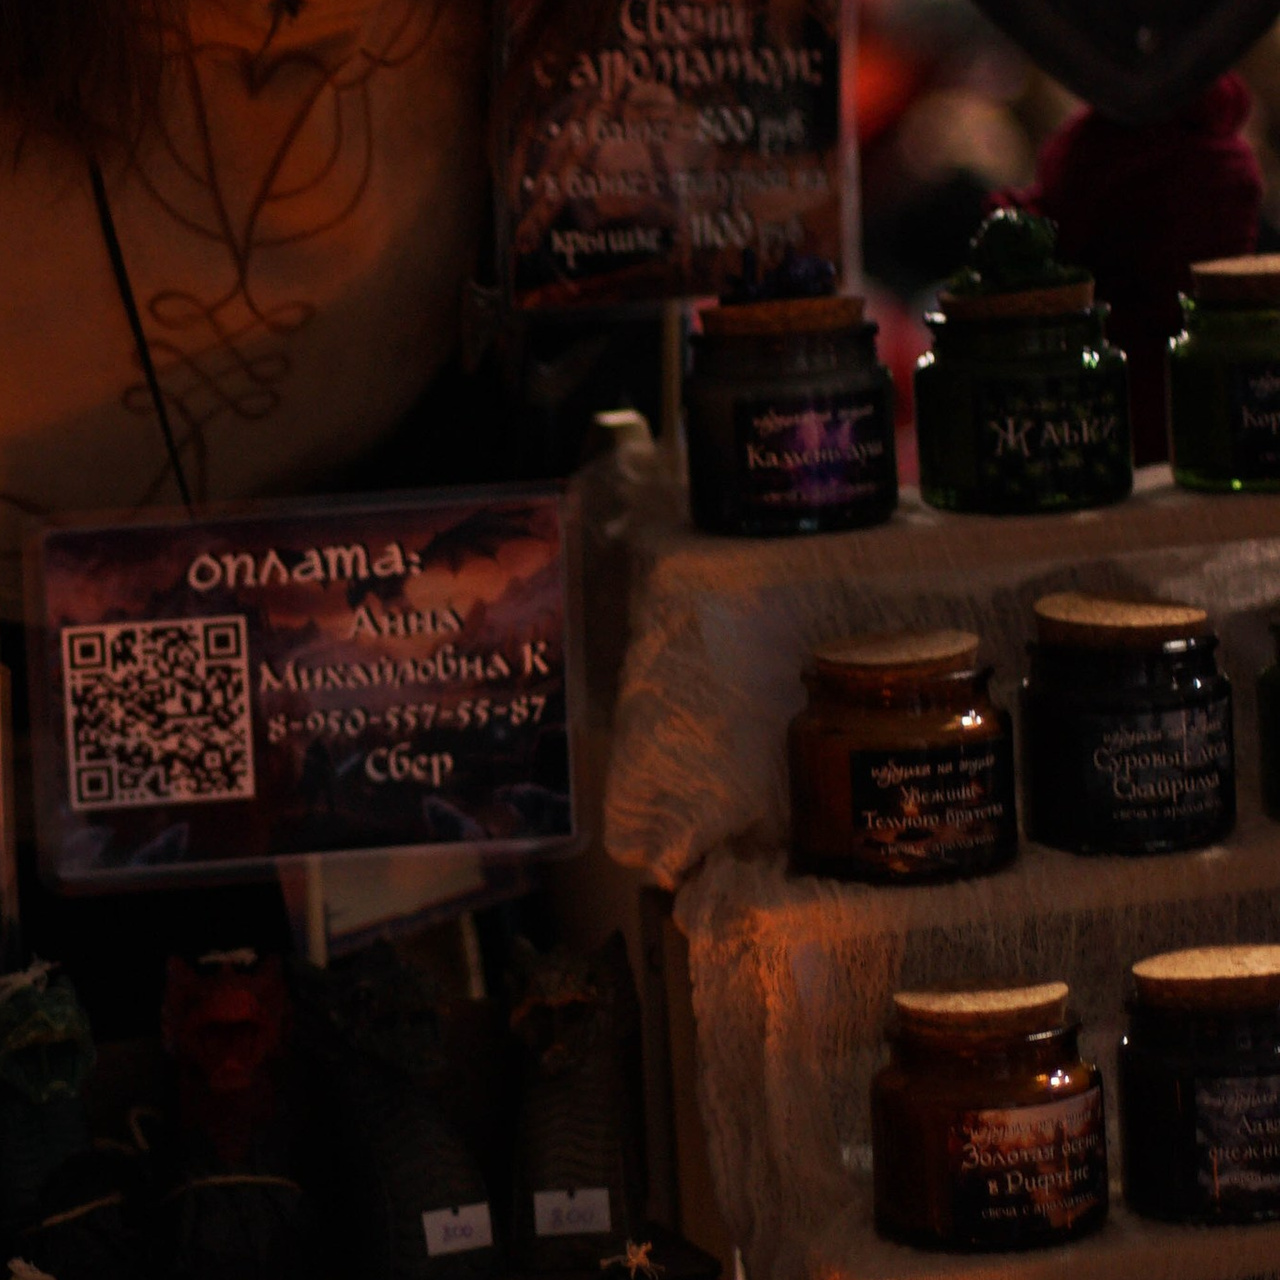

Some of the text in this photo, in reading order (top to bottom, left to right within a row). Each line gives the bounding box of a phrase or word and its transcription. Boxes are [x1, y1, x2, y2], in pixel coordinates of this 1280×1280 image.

[187, 541, 423, 593] оплата:
[347, 604, 464, 640] Анна
[259, 639, 550, 694] Михайловна К
[365, 739, 456, 788] Сбер
